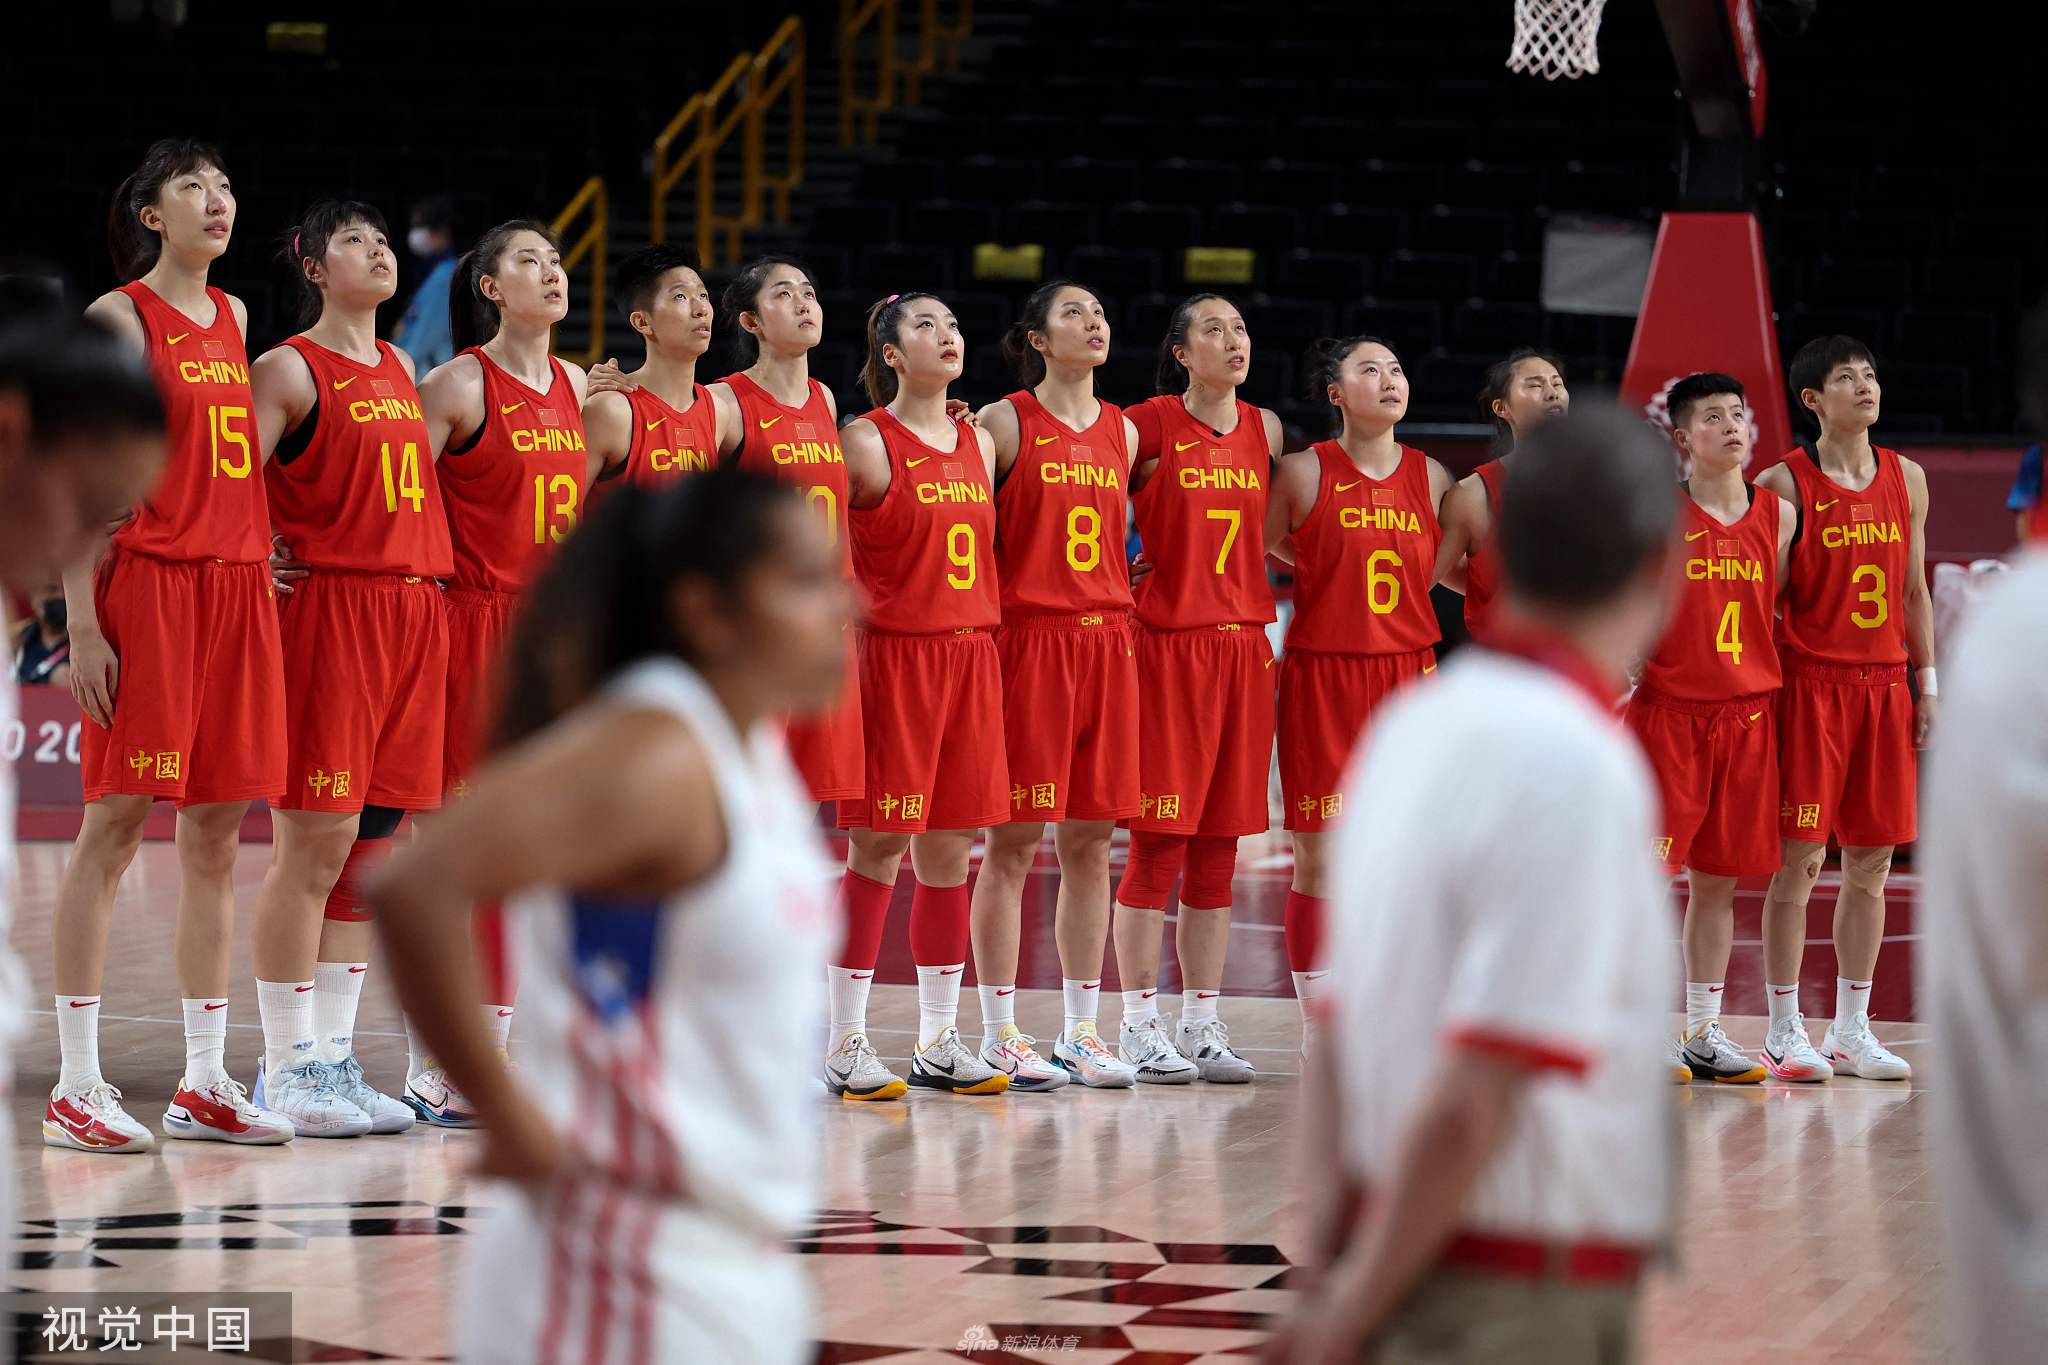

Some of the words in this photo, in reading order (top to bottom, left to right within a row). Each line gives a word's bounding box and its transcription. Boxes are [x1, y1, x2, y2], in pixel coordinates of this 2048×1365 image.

[179, 361, 249, 385] CHINA
[349, 399, 424, 423] CHINA
[208, 405, 252, 479] 15
[511, 429, 586, 452] CHINA
[771, 442, 845, 465] CHINA
[650, 448, 709, 472] CHIN
[381, 442, 425, 513] 14
[1040, 462, 1120, 490] CHINA
[1179, 467, 1261, 491] CHINA
[916, 481, 989, 505] CHINA
[534, 474, 578, 544] 13
[1339, 507, 1422, 534] CHINA
[1066, 506, 1101, 573] 8
[1206, 509, 1241, 575] 7
[1822, 521, 1902, 549] CHINA
[947, 523, 977, 590] 9
[1686, 558, 1763, 583] CHINA
[1366, 550, 1403, 615] 6
[1851, 564, 1888, 629] 3
[1081, 616, 1104, 626] CHN
[1716, 601, 1744, 665] 4
[129, 750, 181, 780] 中国
[308, 769, 351, 798] 中国
[1010, 783, 1056, 811] 中国
[877, 794, 924, 821] 中国
[1298, 793, 1342, 821] 中国
